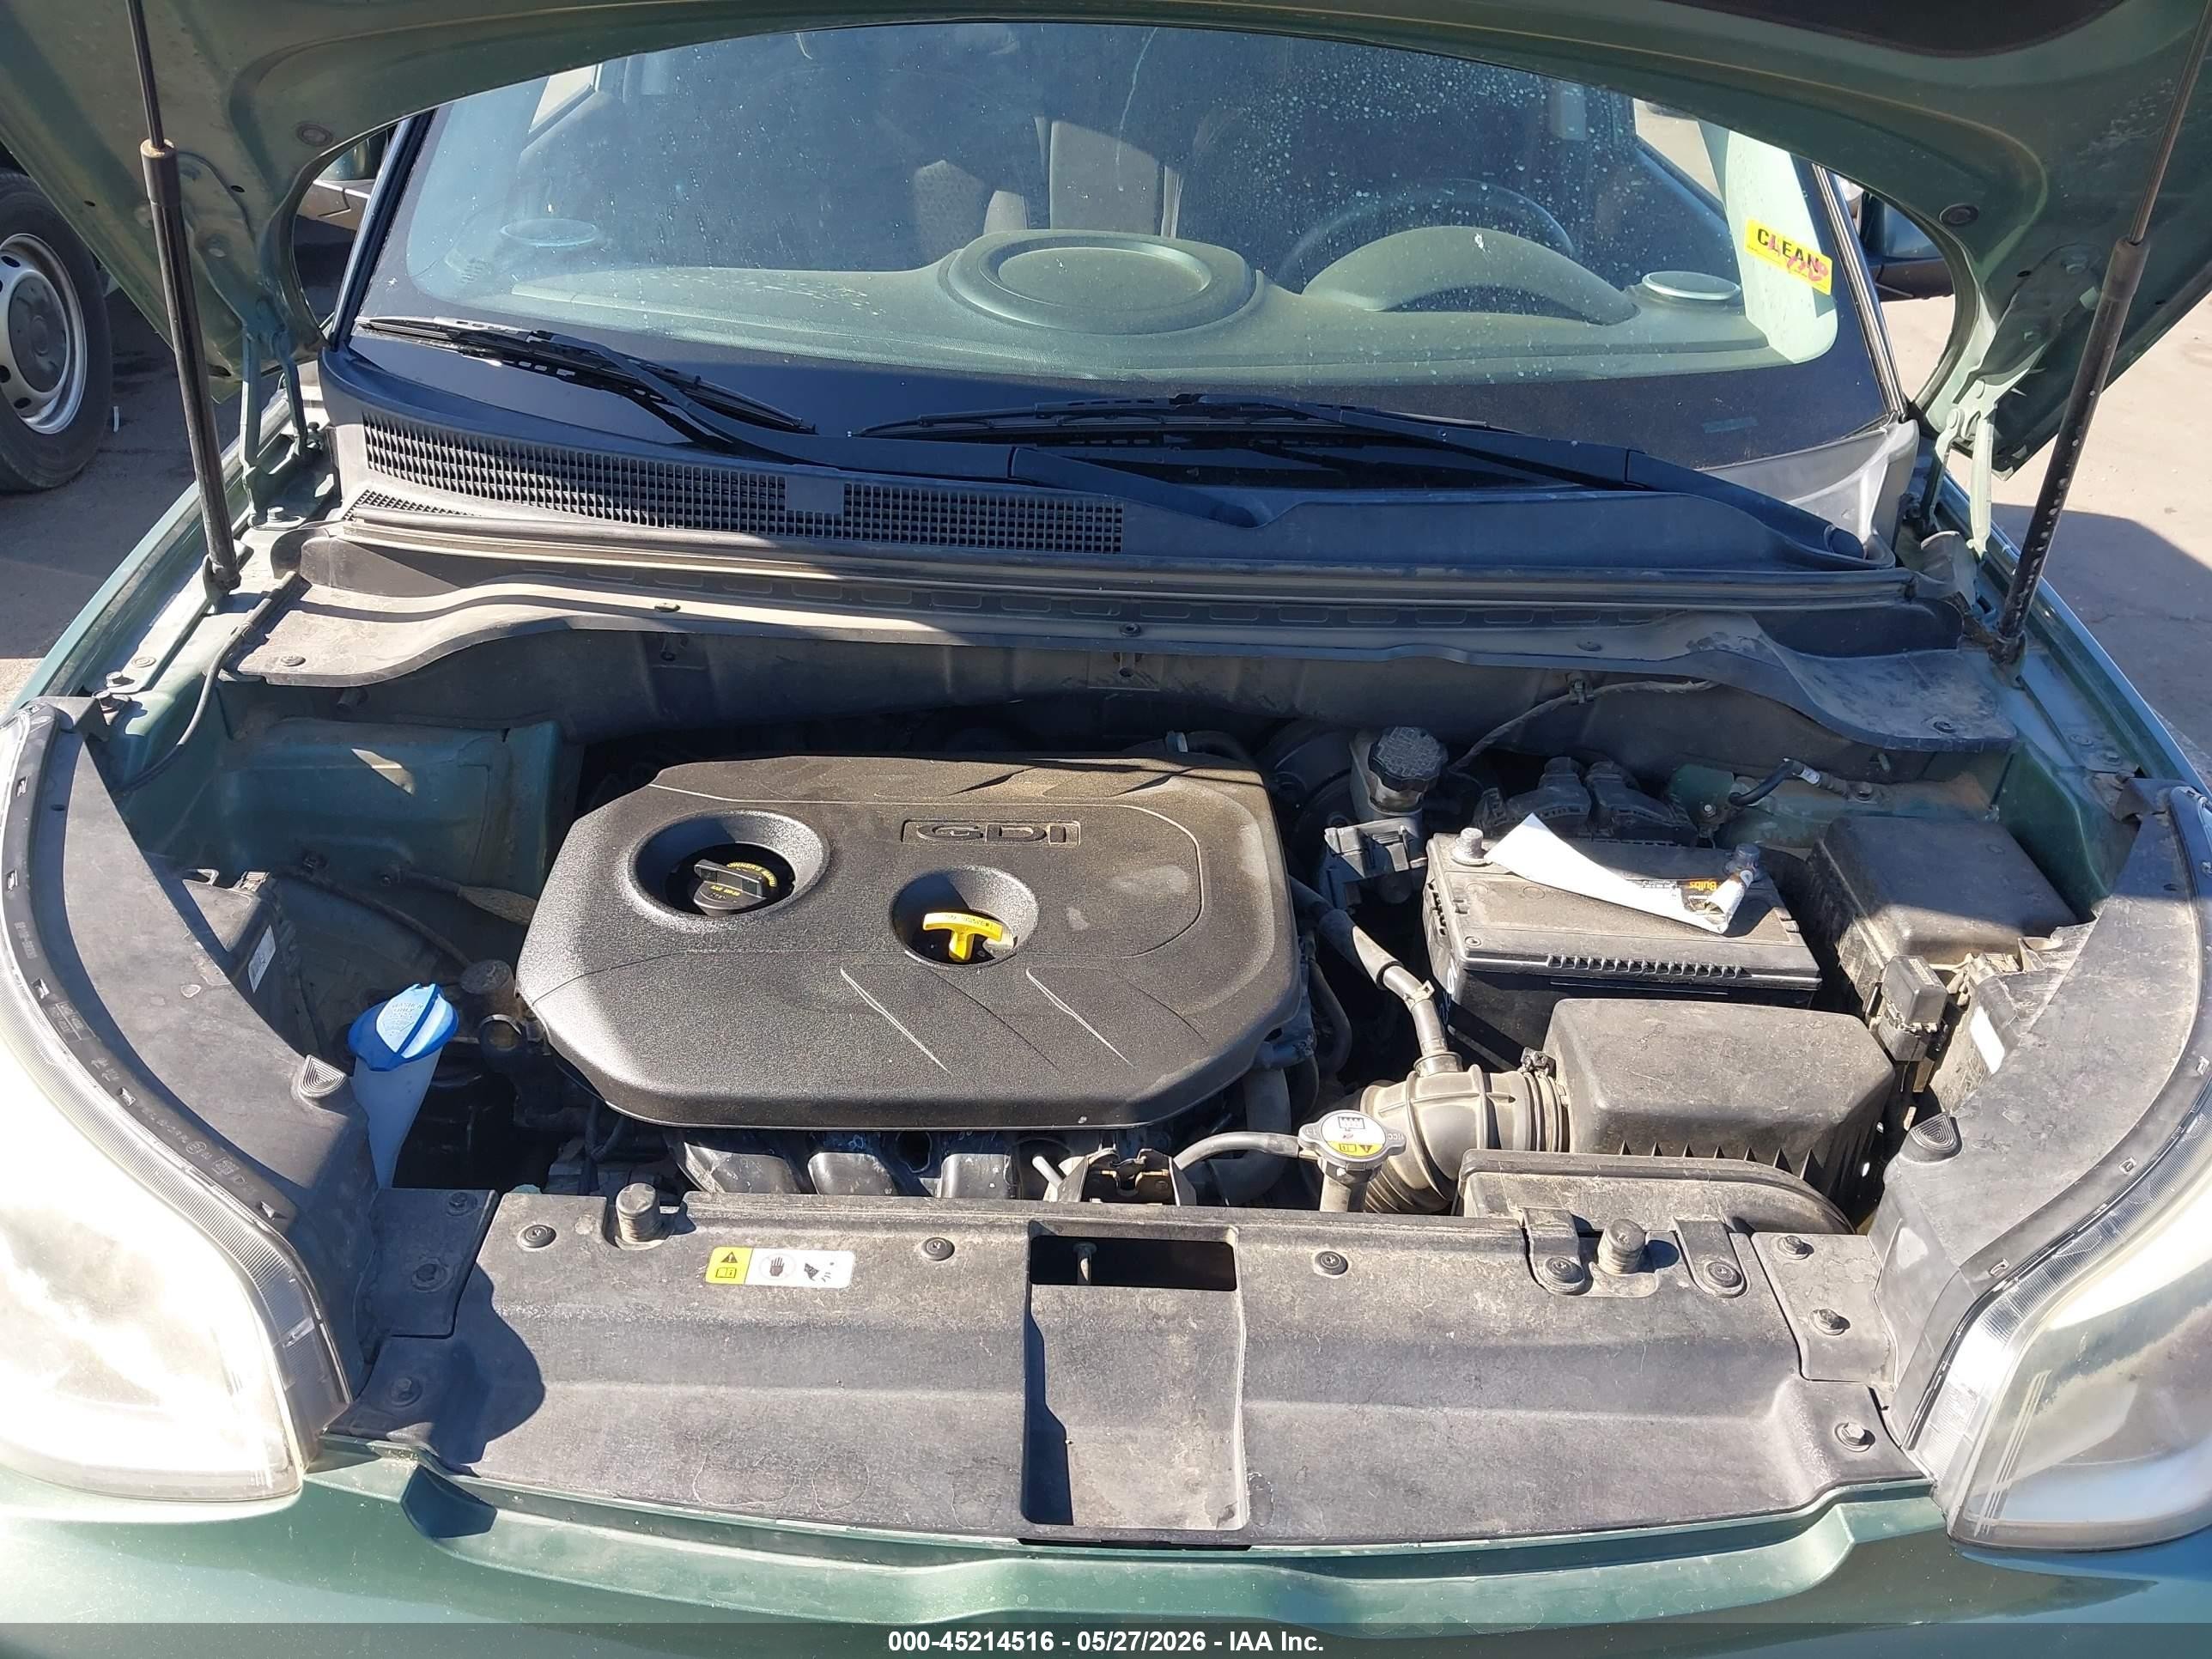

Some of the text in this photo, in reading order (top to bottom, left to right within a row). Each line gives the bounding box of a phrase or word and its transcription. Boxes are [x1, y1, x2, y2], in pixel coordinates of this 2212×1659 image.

[1757, 228, 1819, 273] CLEAN
[917, 823, 1067, 843] GDI
[1688, 881, 1717, 891] Bulbs
